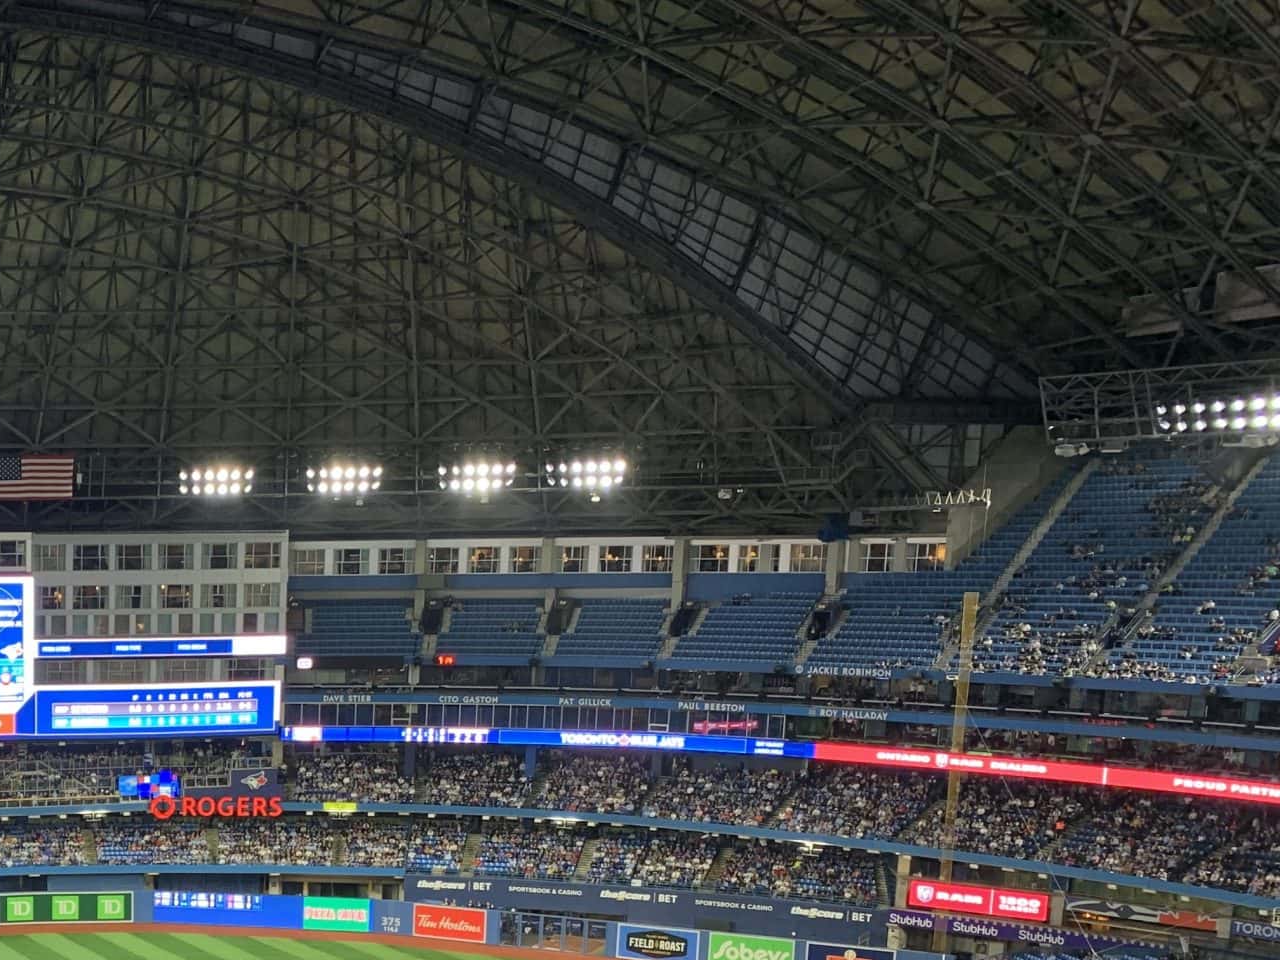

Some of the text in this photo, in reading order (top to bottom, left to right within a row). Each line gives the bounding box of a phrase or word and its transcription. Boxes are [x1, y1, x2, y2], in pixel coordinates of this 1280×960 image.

[808, 666, 892, 678] JACKIE ROBINSON
[323, 694, 344, 702] DAVE
[438, 696, 498, 704] CITO GASTON
[558, 697, 612, 706] PAT GILLICK
[678, 702, 745, 712] PAUL BEESTON
[820, 708, 888, 721] ROY HALLADAY
[560, 733, 684, 748] TORONTO BLUE JAYS
[876, 751, 930, 764] ONTARIO
[990, 760, 1047, 774] DEALERS
[1174, 778, 1227, 792] PROUD
[181, 796, 282, 817] ROGERS
[417, 880, 492, 892] theScore BET
[508, 886, 551, 896] SPORTSBOOK
[600, 890, 678, 904] theScore BET
[10, 900, 31, 918] TD
[54, 900, 76, 918] TD
[100, 900, 121, 916] TD
[695, 900, 739, 910] SPORTSBOOK
[746, 903, 774, 912] CASINO
[381, 916, 401, 926] 375
[790, 906, 872, 923] theScore BET
[888, 912, 933, 929] StubHub
[416, 914, 481, 932] Tim Hortons
[952, 921, 998, 938] StubHub
[629, 937, 654, 949] FIELD
[659, 940, 686, 952] ROAST
[1018, 930, 1065, 946] StubHub
